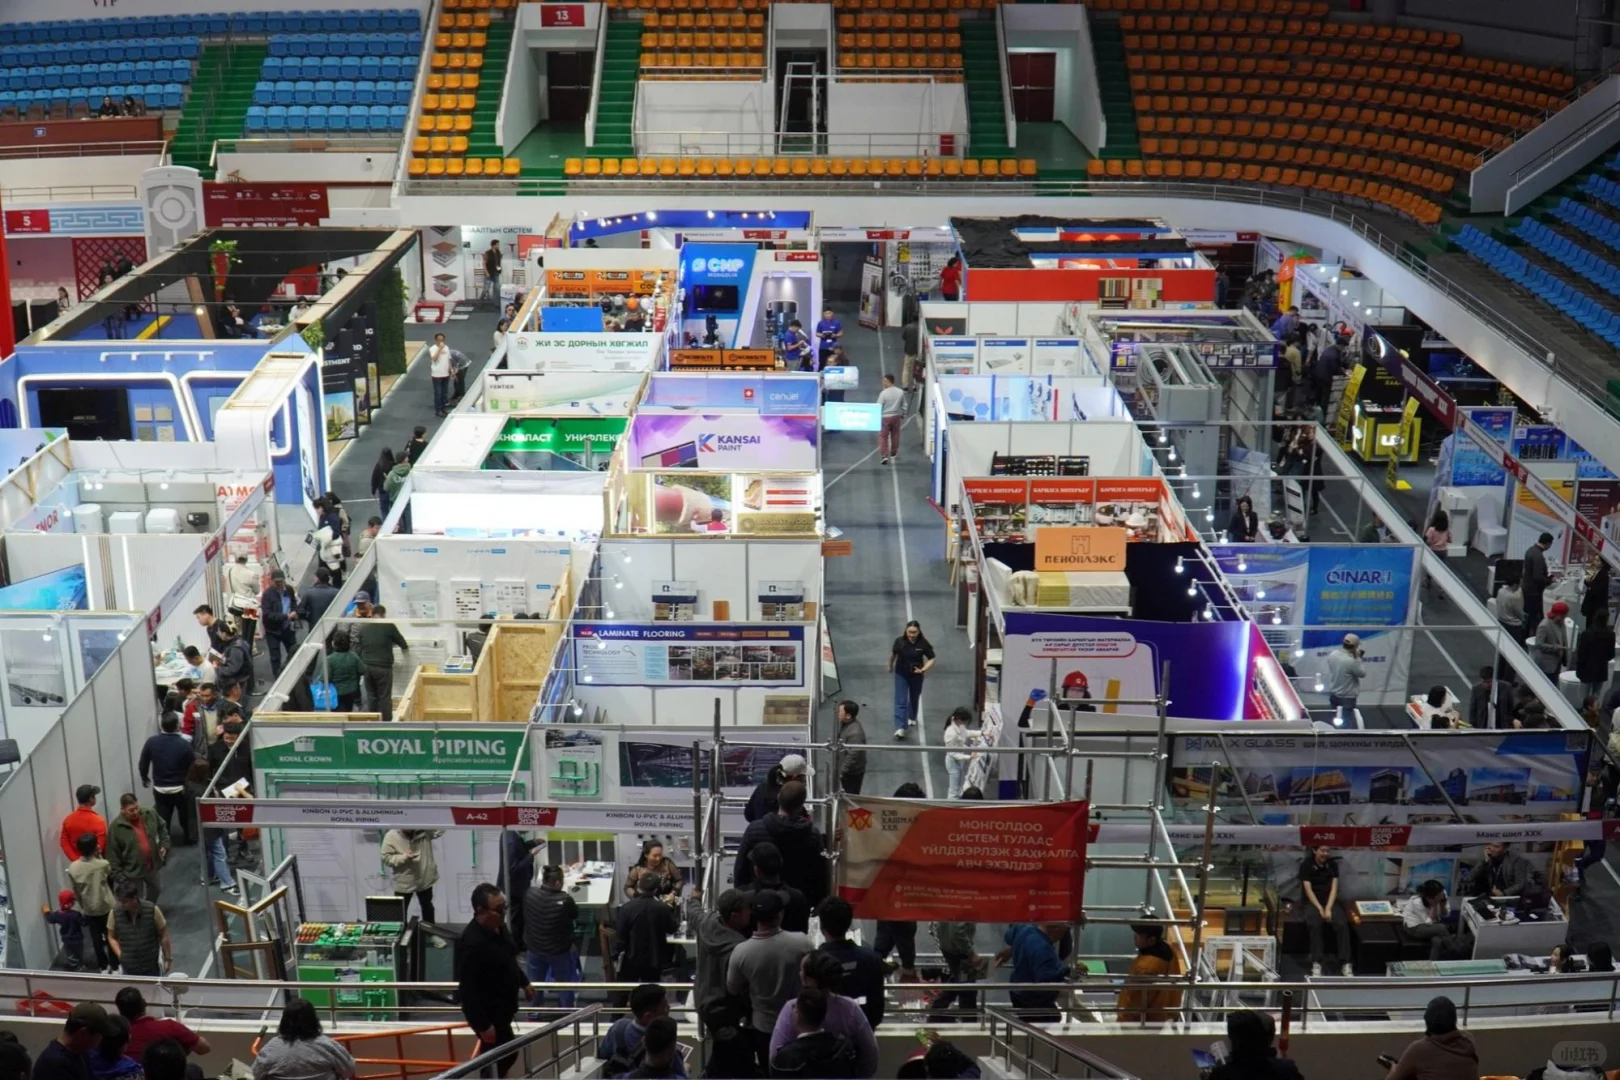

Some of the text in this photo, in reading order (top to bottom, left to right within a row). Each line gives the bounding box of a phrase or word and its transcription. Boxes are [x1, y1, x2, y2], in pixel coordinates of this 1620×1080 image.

[556, 10, 569, 21] 13
[23, 215, 31, 226] 5
[707, 258, 744, 273] CNP
[535, 339, 551, 348] ЖИ
[567, 339, 607, 349] ДОРНЫН
[717, 435, 761, 445] KANSAI
[717, 444, 743, 452] PAINT
[598, 629, 639, 637] LAMINATE
[642, 629, 686, 638] FLOORING
[357, 738, 506, 756] ROYAL PIPING
[1244, 738, 1296, 748] GLASS
[279, 755, 332, 763] ROYAL CROWN
[433, 756, 471, 765] Application
[959, 819, 1043, 833] МОНГОЛДОО
[947, 832, 1054, 847] СИСТЕМ ТУЛААС
[1313, 832, 1336, 841] A-28
[1012, 847, 1079, 859] ЗАХИАЛГА
[956, 859, 1043, 872] АВЧ ЭХЭЛЛЭЭ
